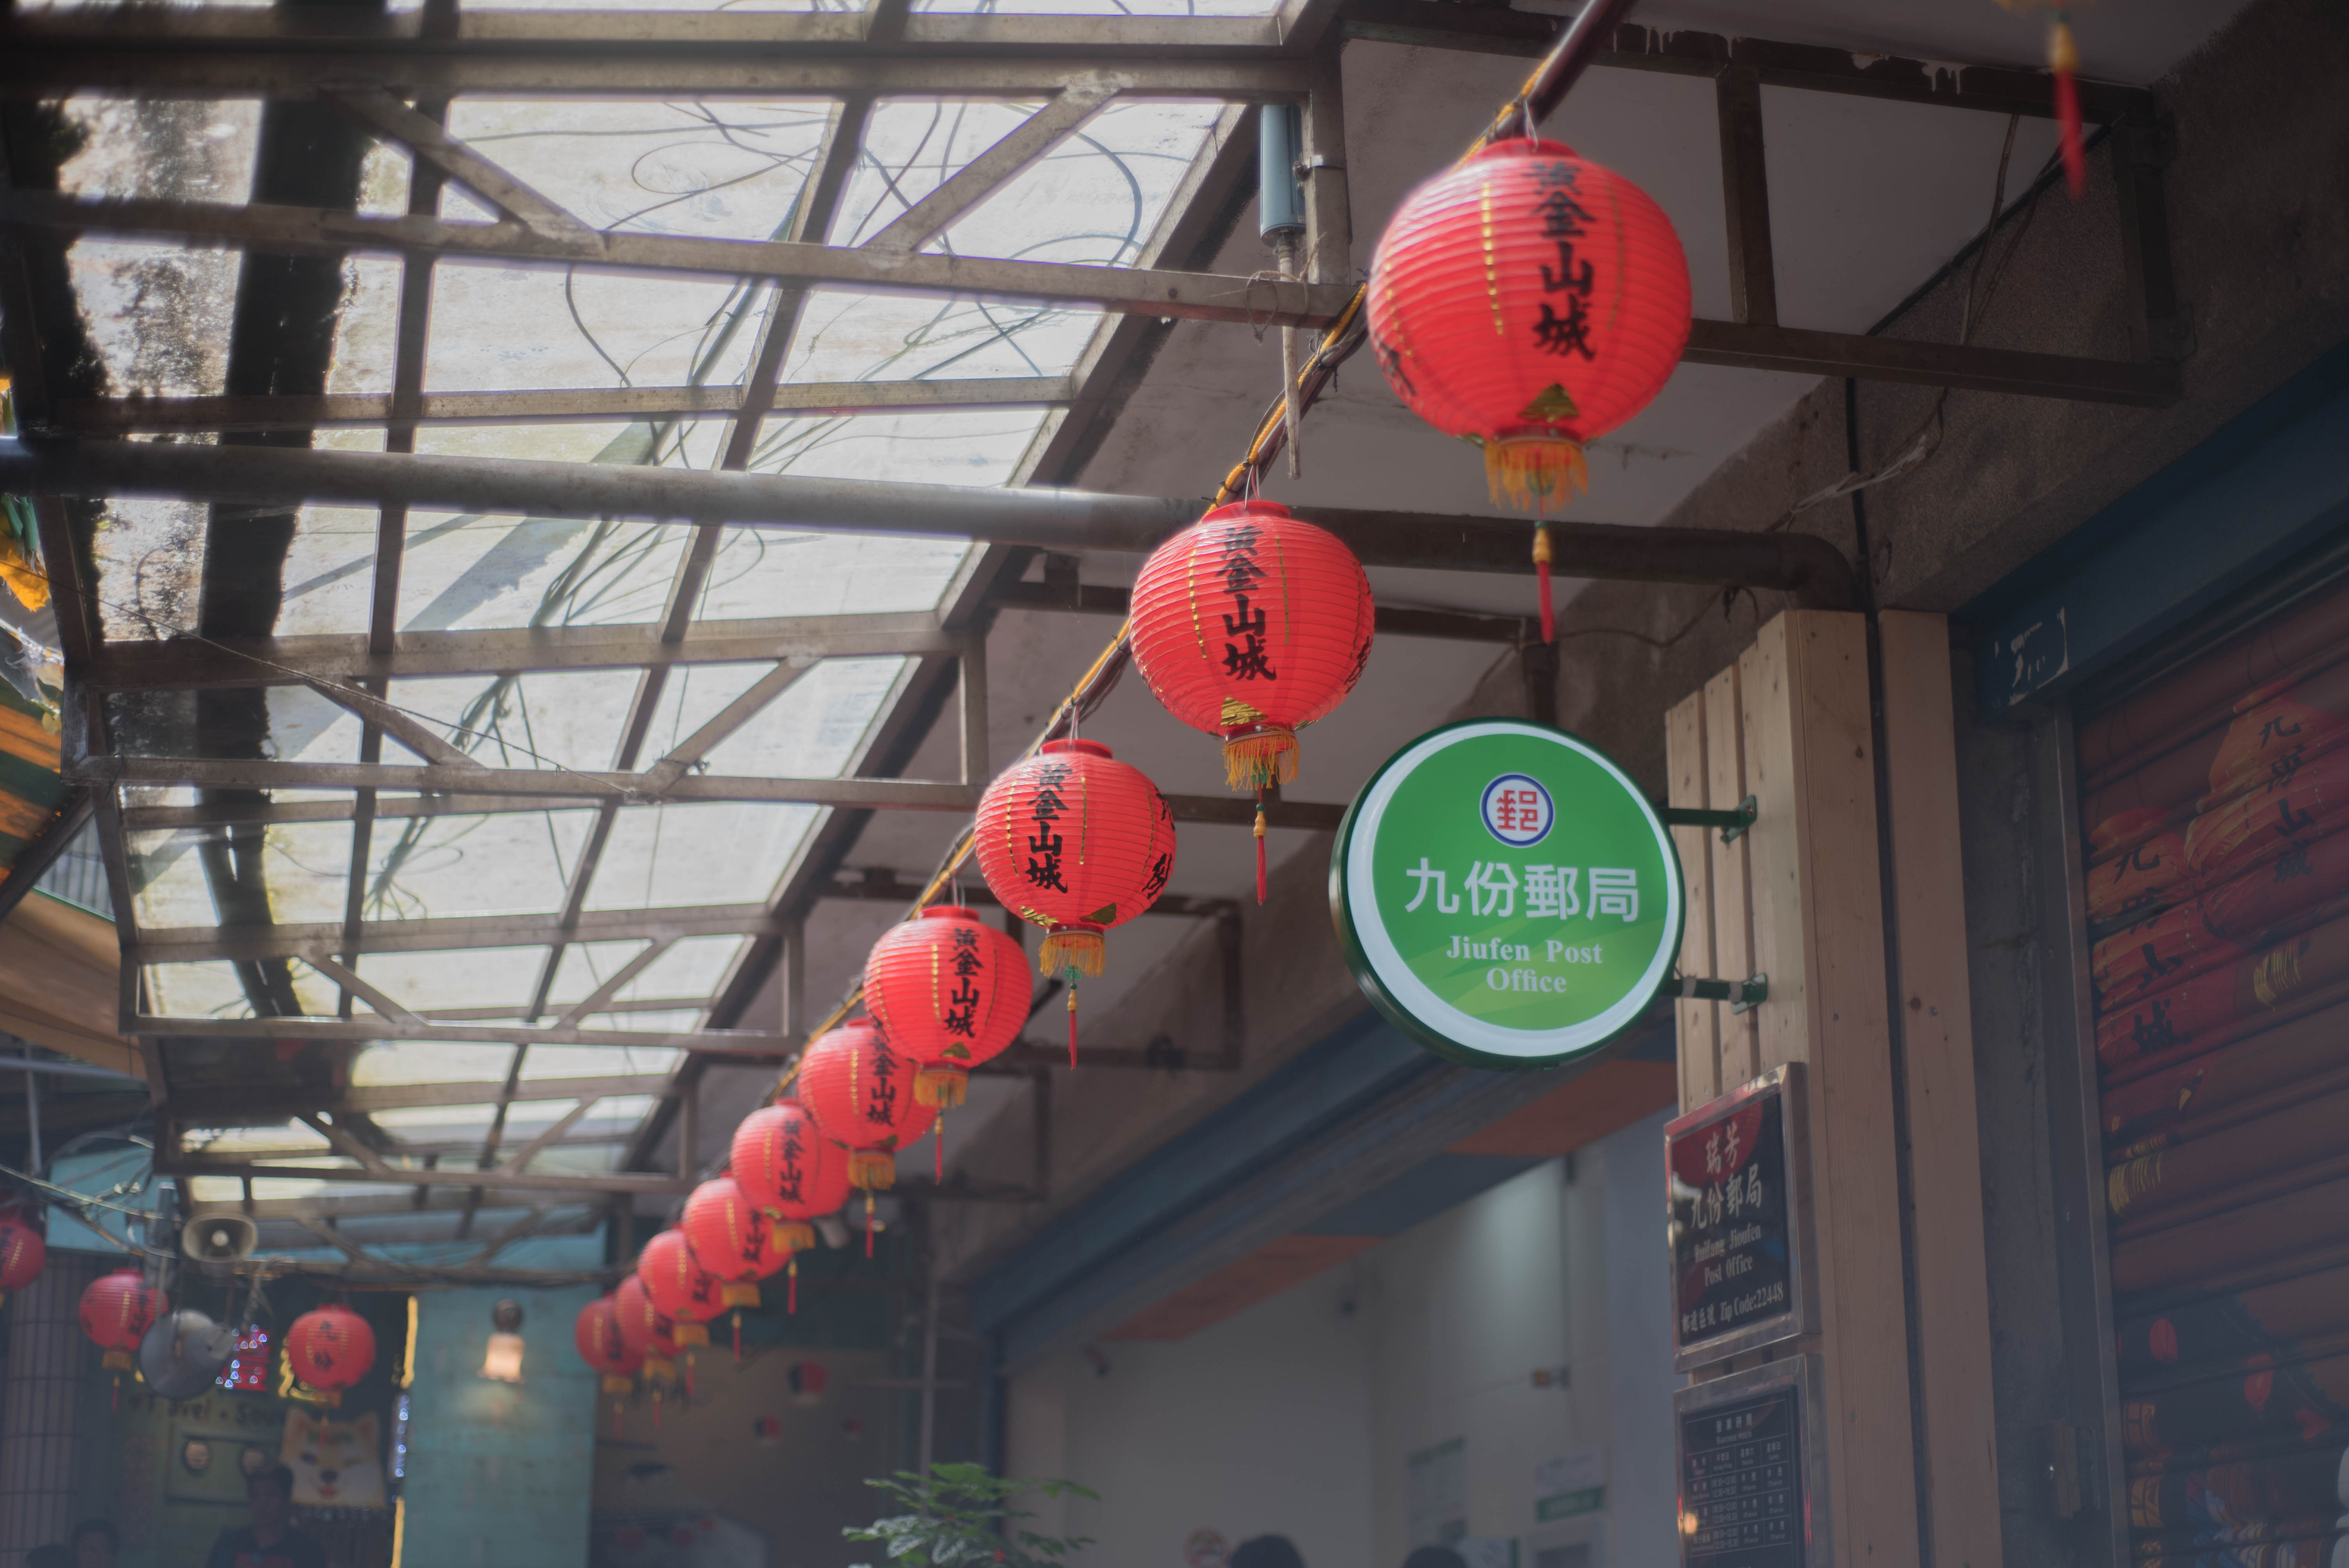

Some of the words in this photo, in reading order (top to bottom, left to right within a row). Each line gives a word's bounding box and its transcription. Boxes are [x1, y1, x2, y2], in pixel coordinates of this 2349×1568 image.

[1404, 857, 1639, 923] 九份郵局
[1447, 935, 1530, 962] Jiufen
[1545, 939, 1603, 964] Post
[1486, 967, 1567, 993] Office
[1705, 1120, 1741, 1174] 瑞芳
[1691, 1163, 1762, 1231] 九份郵局
[1695, 1238, 1725, 1264] Ruifang
[1729, 1222, 1762, 1251] Jioufen
[1704, 1265, 1723, 1287] Post
[1726, 1255, 1754, 1278] Office
[1720, 1300, 1737, 1322] Zip
